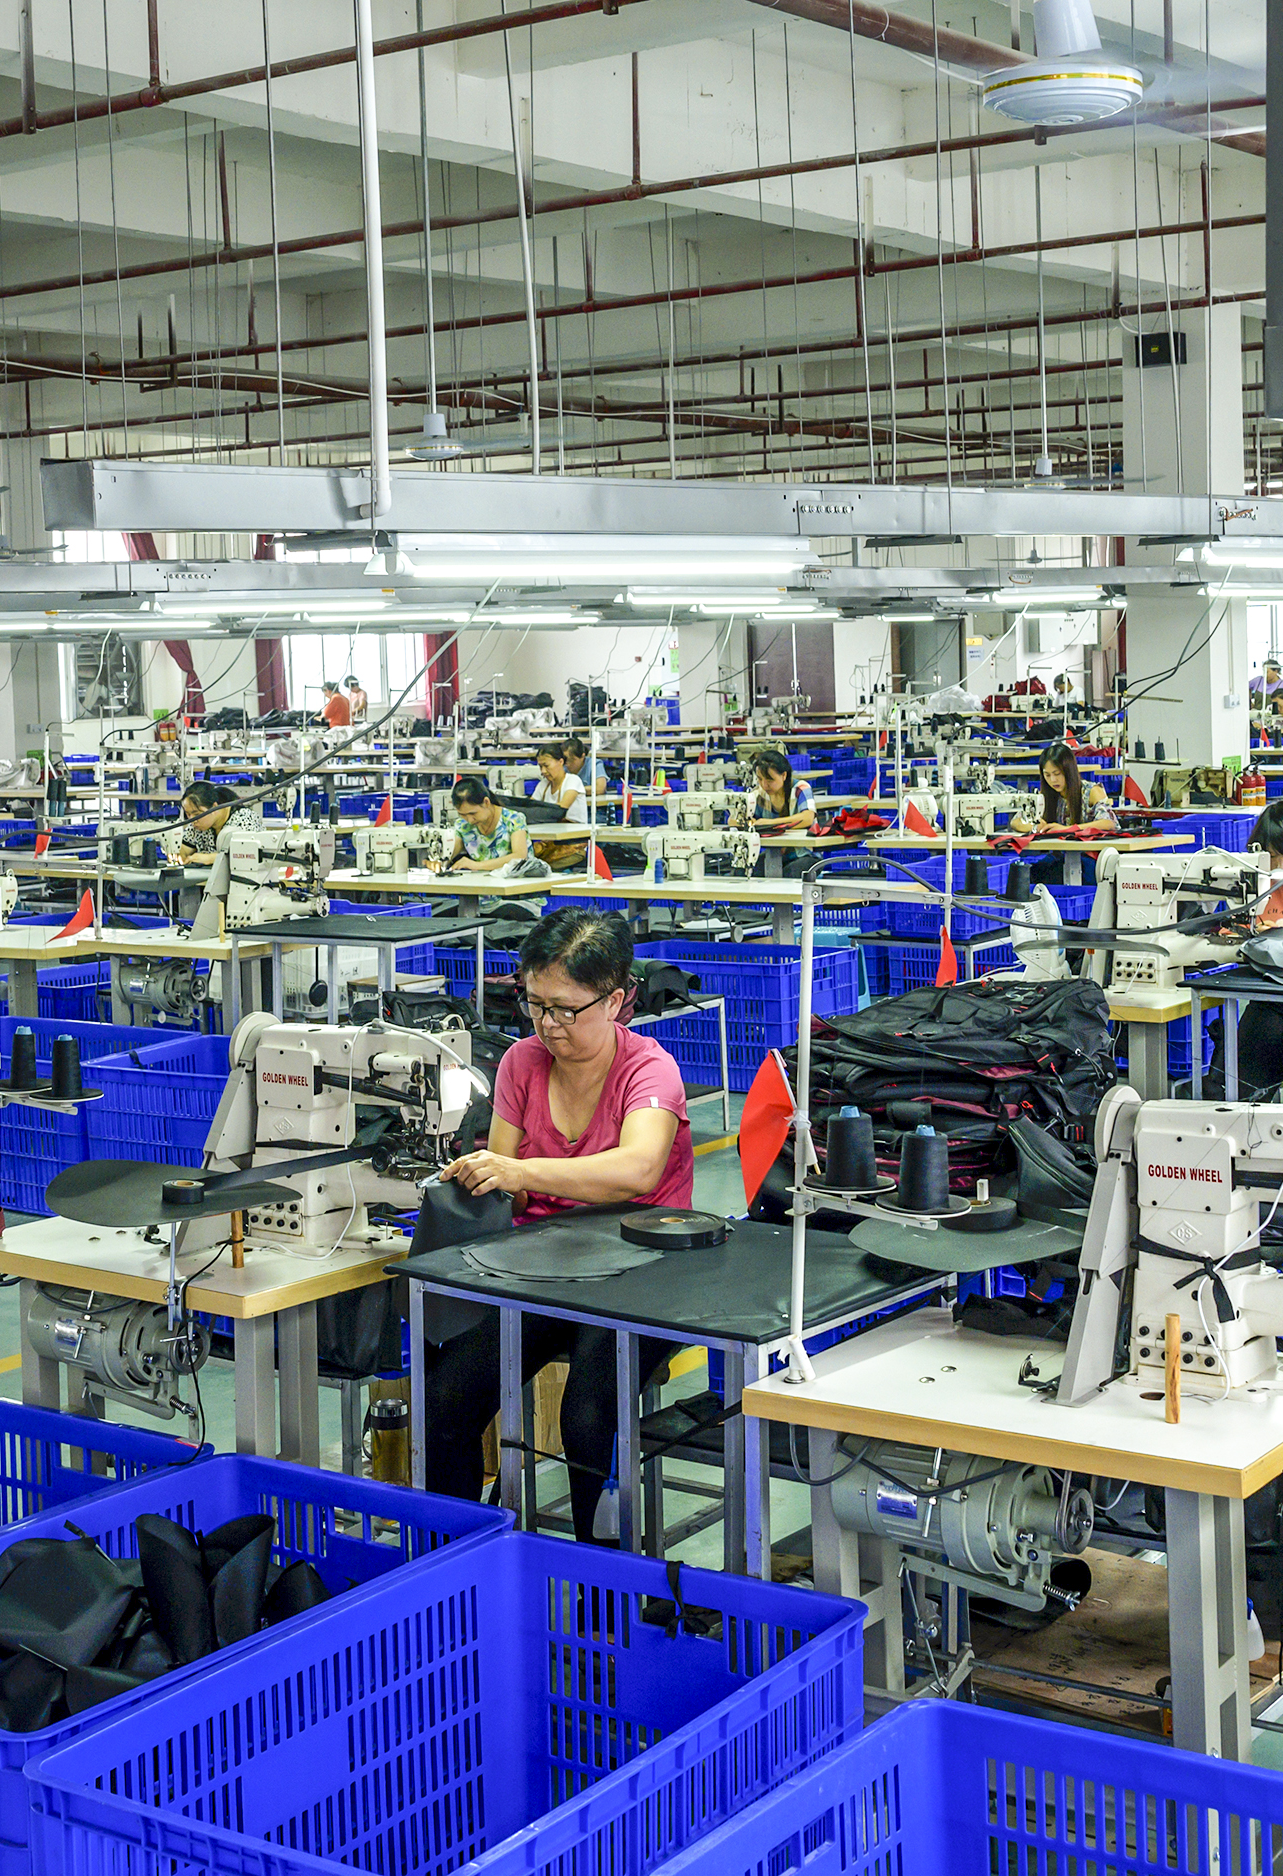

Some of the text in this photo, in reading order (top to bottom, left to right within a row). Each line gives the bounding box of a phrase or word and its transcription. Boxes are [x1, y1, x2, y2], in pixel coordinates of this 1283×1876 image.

[262, 1072, 309, 1087] GOLDEN WHEEL
[1148, 1164, 1223, 1183] GOLDEN WHEEL
